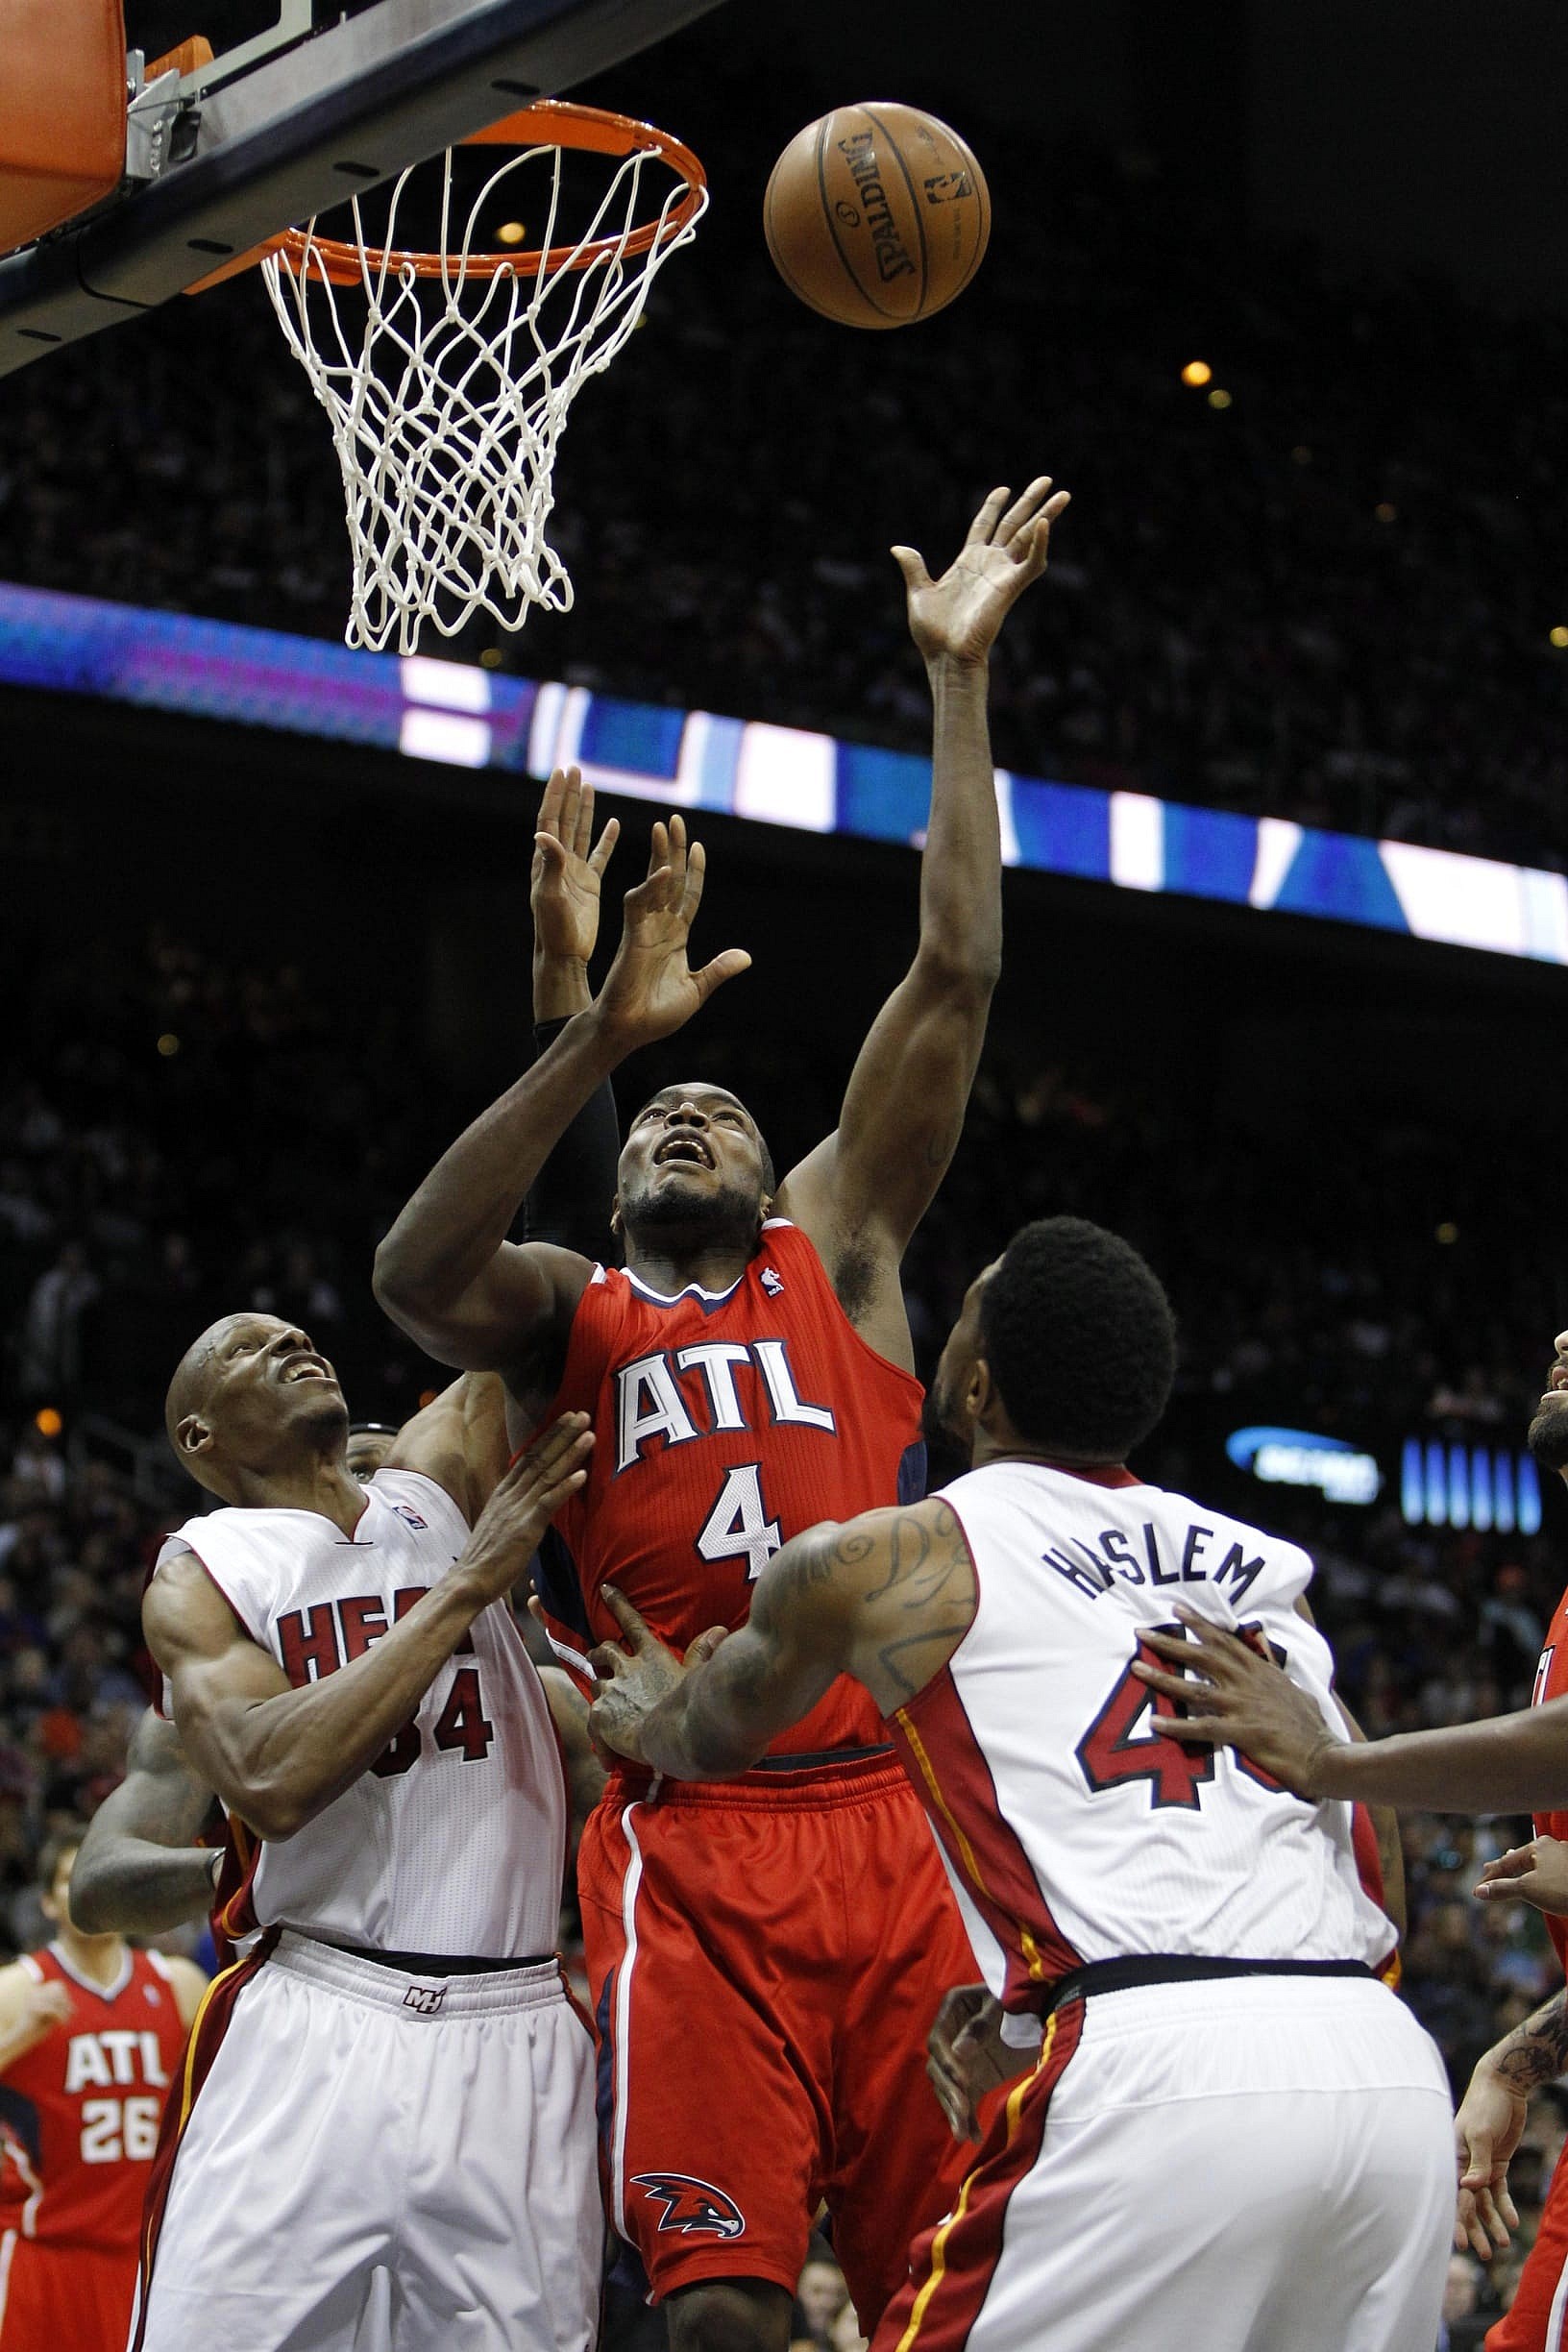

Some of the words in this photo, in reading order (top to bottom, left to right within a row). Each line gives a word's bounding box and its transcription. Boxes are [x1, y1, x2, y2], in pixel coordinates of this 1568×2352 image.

[838, 129, 916, 283] SPALDING
[612, 1337, 837, 1480] ATL
[695, 1460, 785, 1584] 4
[1041, 1523, 1266, 1606] HASLEM
[276, 1586, 476, 1690] HE
[64, 2030, 170, 2094] ATL
[80, 2095, 160, 2164] 26
